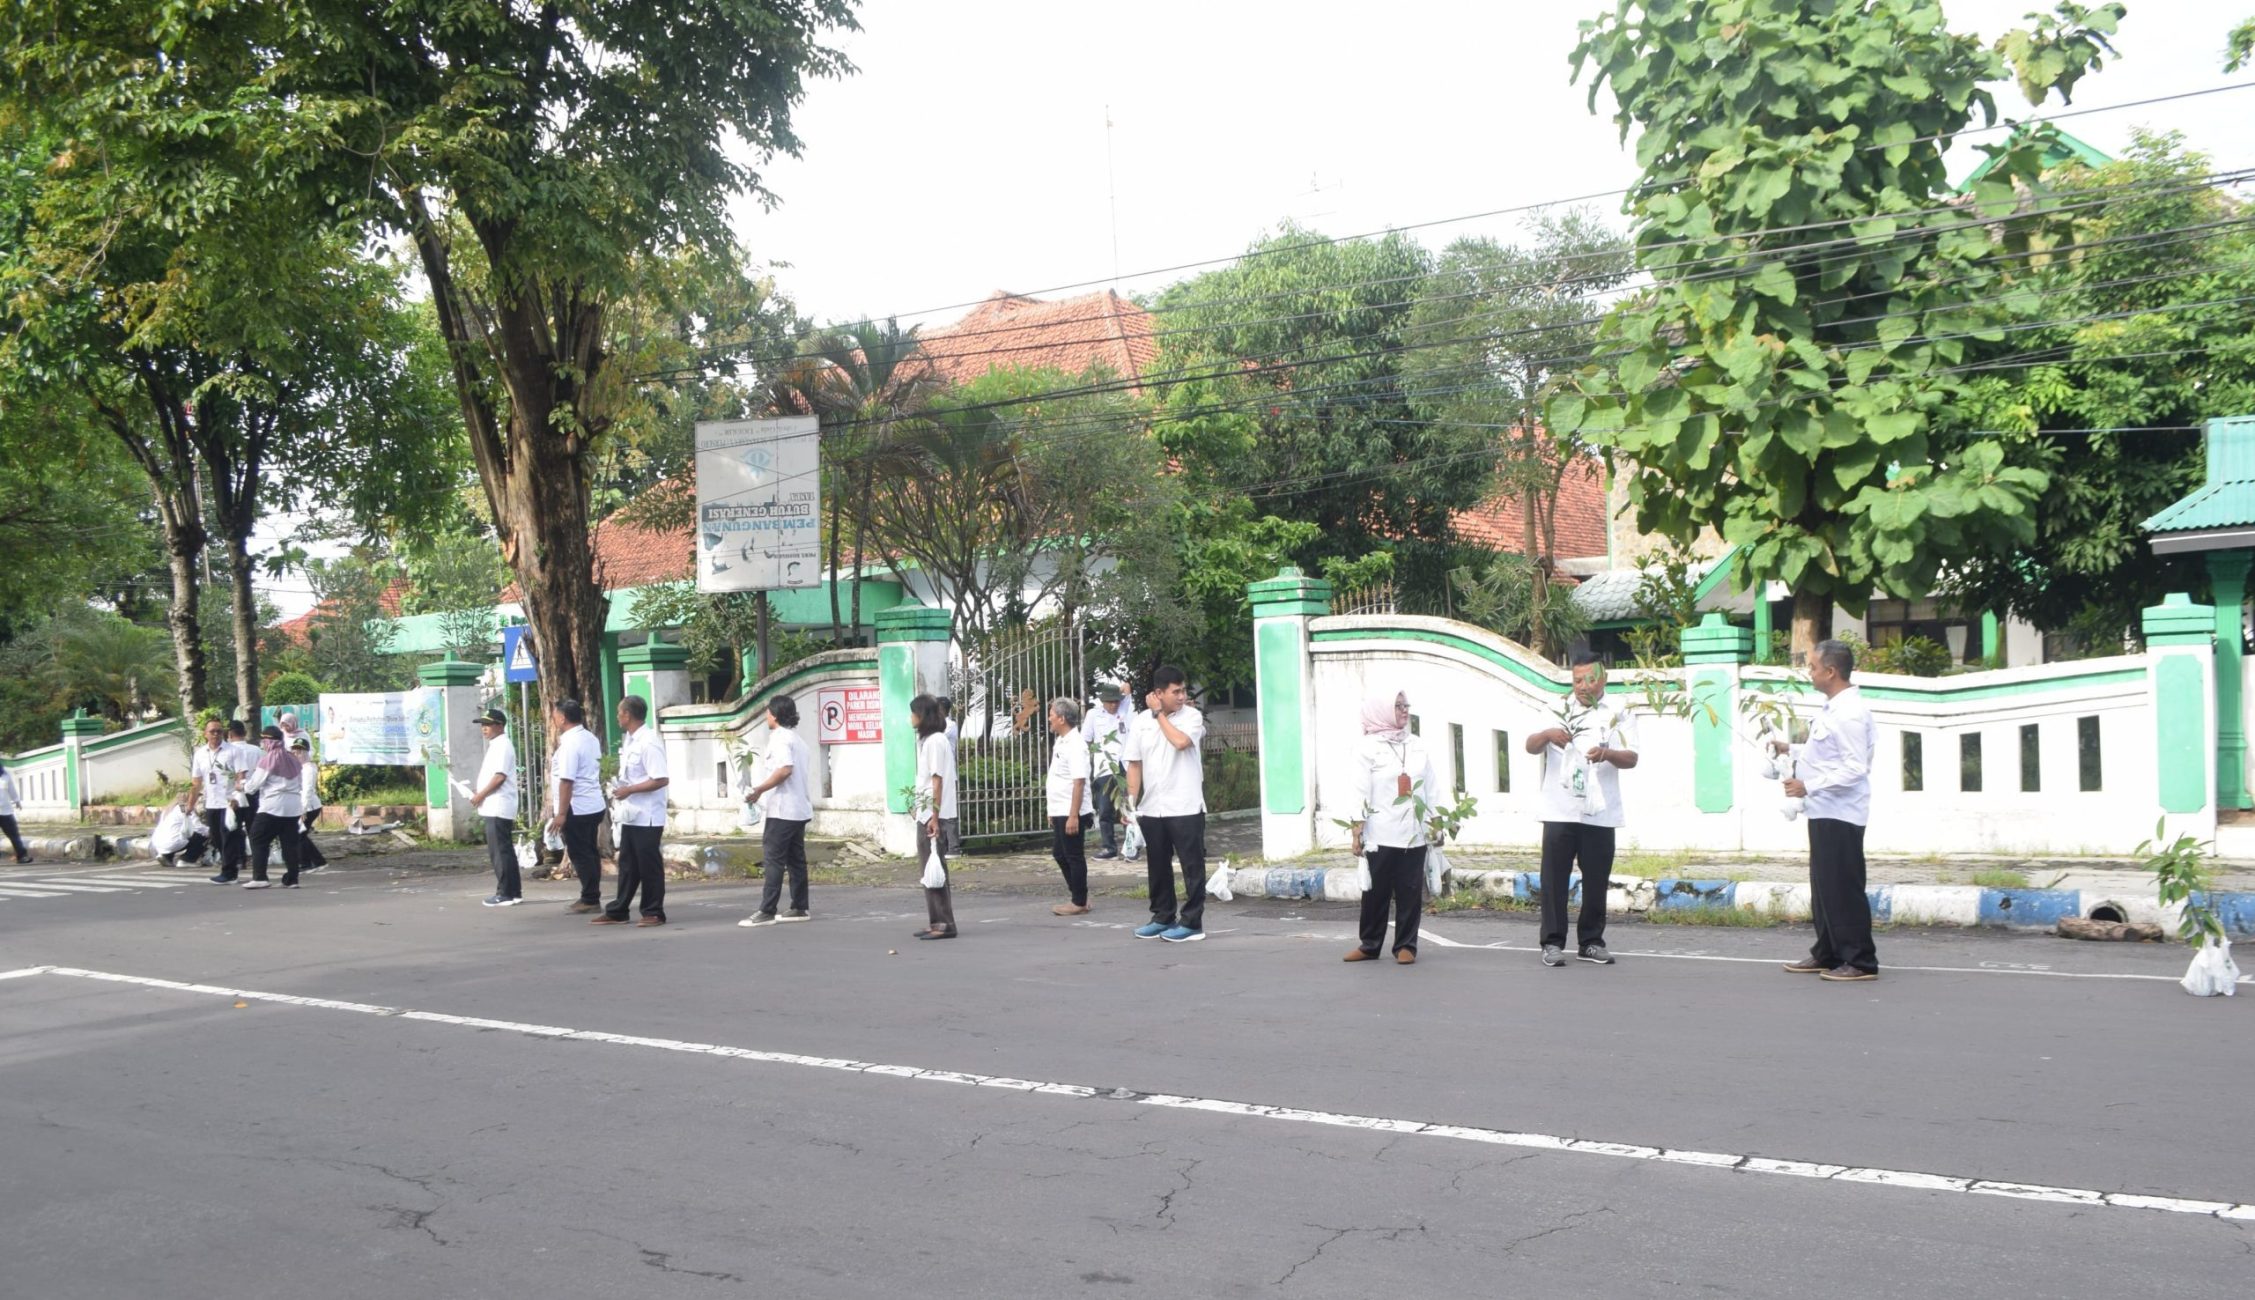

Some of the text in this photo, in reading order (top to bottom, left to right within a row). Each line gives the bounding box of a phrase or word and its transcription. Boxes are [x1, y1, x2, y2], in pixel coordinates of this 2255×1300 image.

[707, 504, 811, 519] BUTUH GENERASI
[702, 518, 817, 533] PEMBANGUNAN
